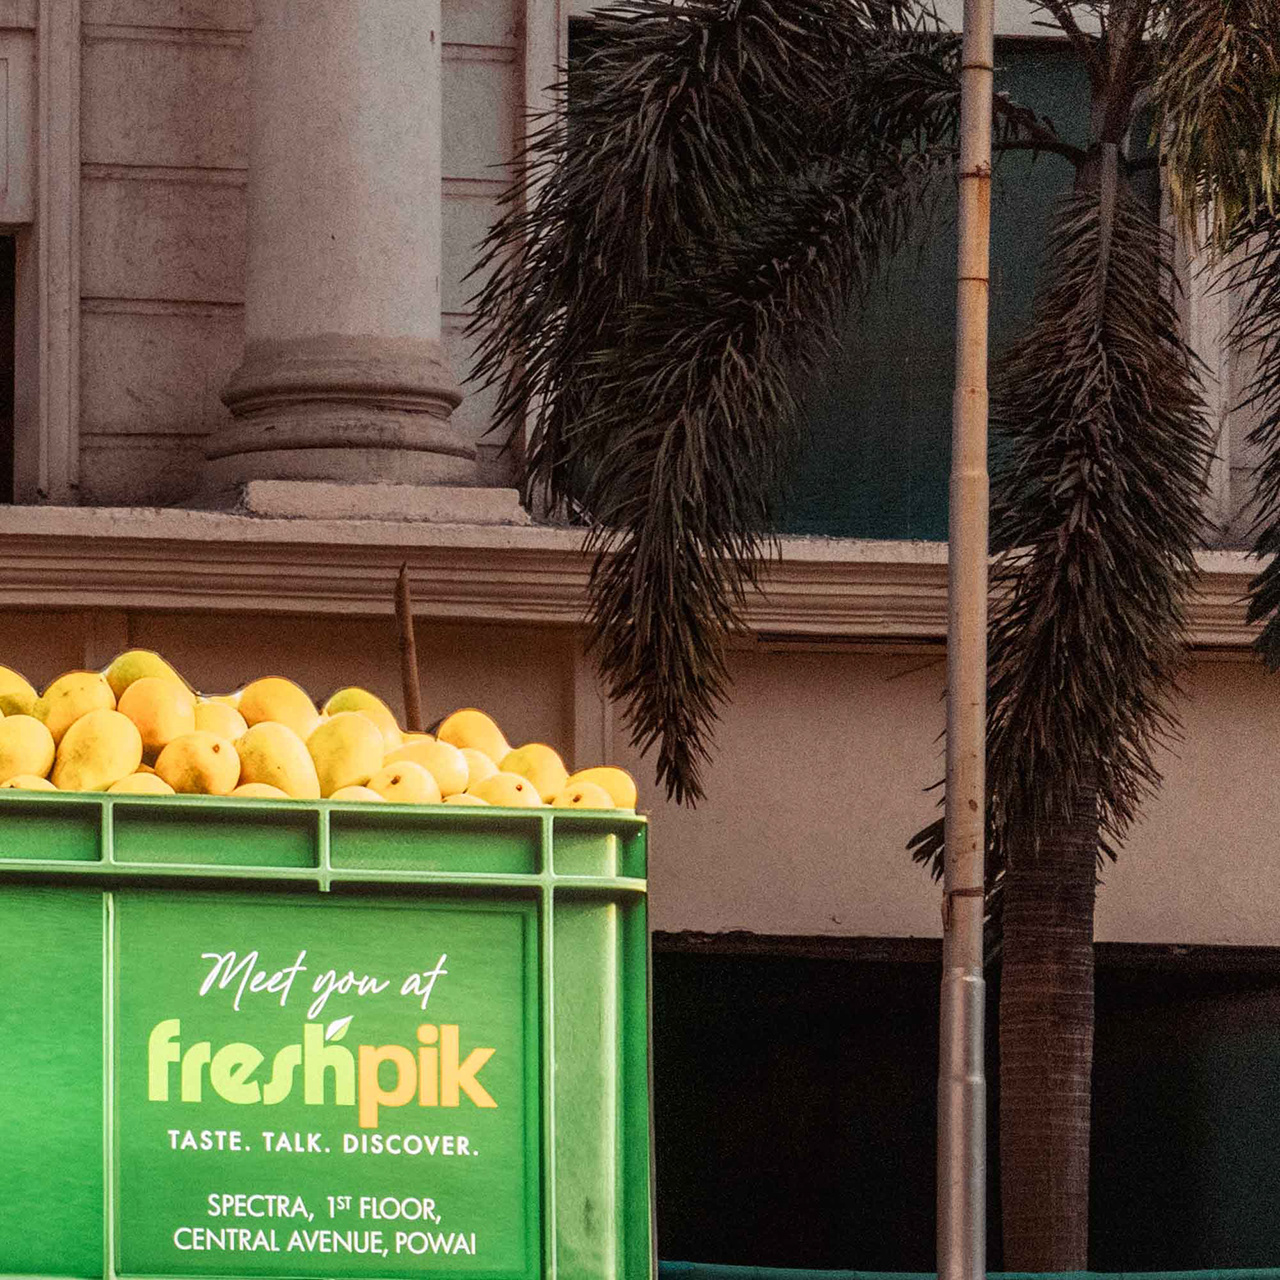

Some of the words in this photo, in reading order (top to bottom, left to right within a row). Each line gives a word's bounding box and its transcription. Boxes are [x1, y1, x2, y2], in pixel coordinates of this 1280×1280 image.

[199, 950, 307, 1011] Meet
[307, 968, 390, 1020] you
[400, 954, 448, 1010] at
[148, 1015, 498, 1128] freshpik
[168, 1129, 251, 1151] TASTE.
[263, 1132, 330, 1153] TALK.
[343, 1133, 479, 1157] DISCOVER.
[208, 1194, 314, 1222] SPECTRA,
[359, 1197, 442, 1225] FLOOR,
[173, 1227, 280, 1252] CENTRAL
[287, 1230, 389, 1257] AVENUE,
[395, 1232, 477, 1255] POWAI
